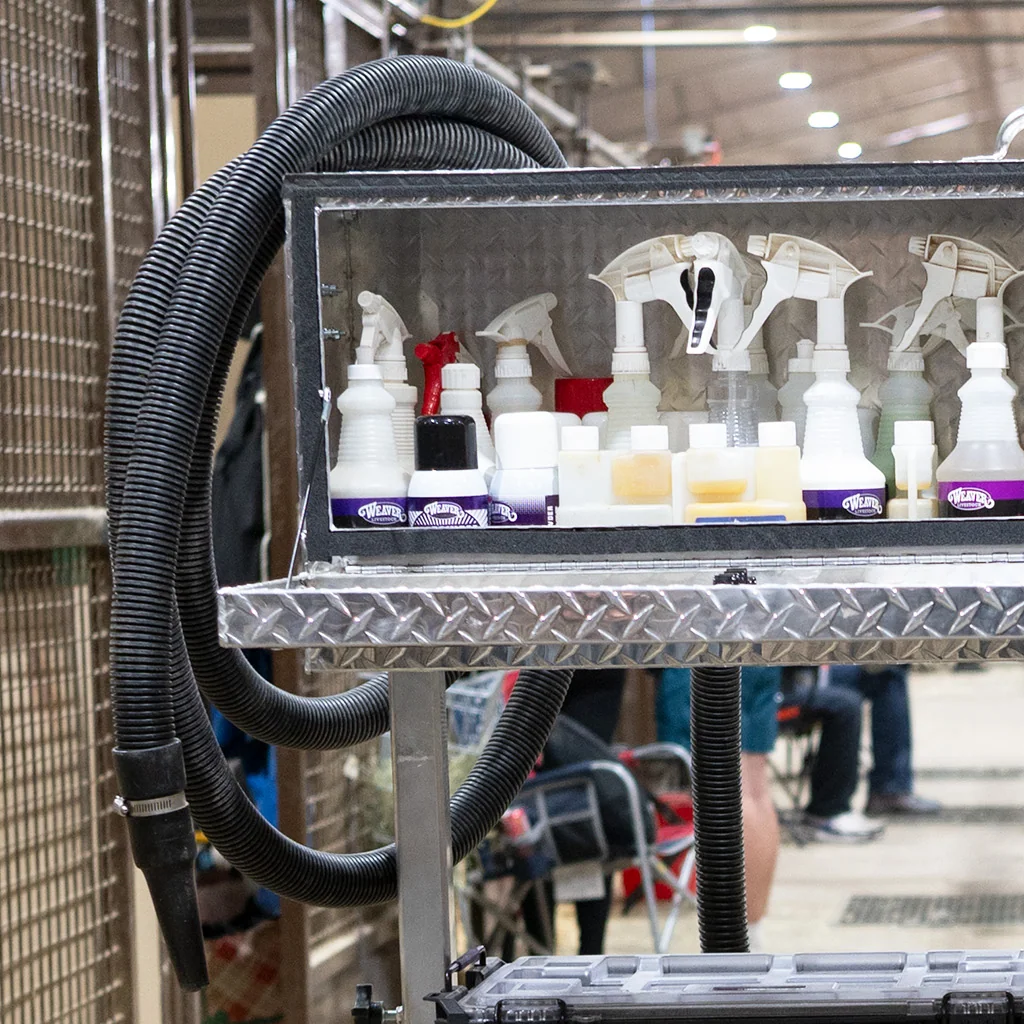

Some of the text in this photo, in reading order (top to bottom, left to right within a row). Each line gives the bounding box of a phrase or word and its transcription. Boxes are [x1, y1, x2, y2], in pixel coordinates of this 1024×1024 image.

[842, 493, 882, 514] WEAVER
[947, 487, 995, 509] WEAVER
[358, 501, 407, 523] WEAVER
[423, 501, 465, 518] WEAVER
